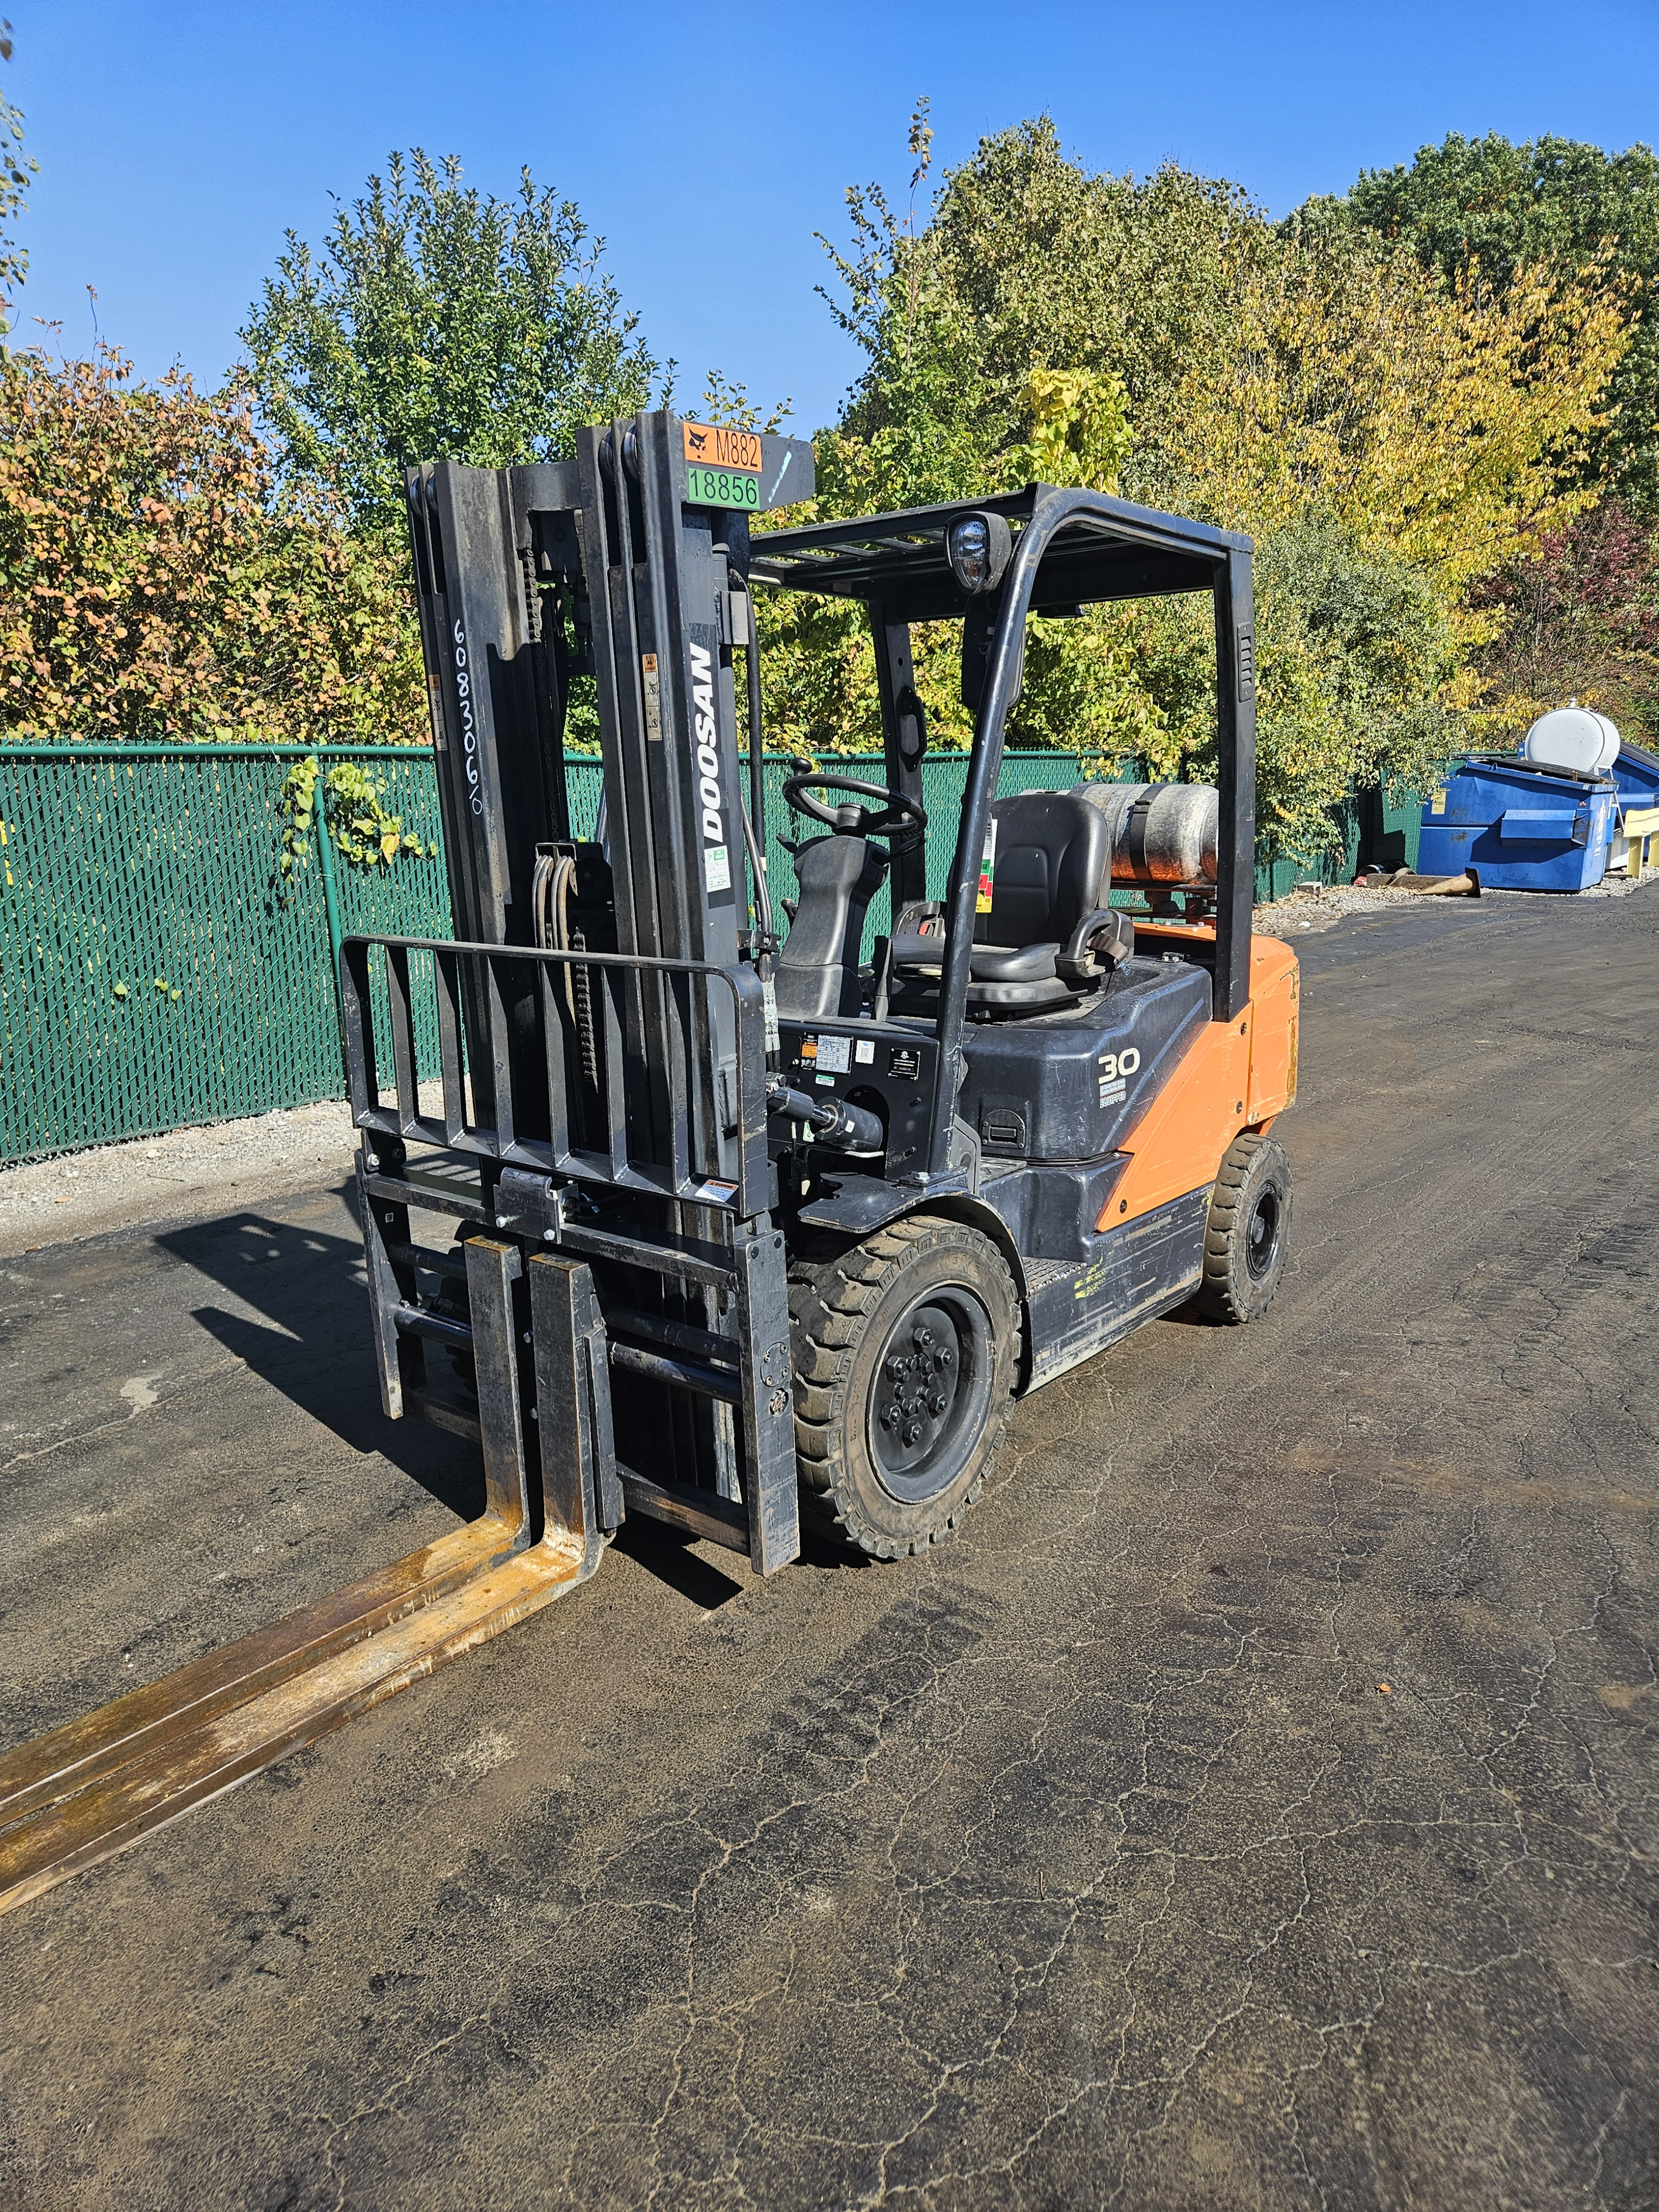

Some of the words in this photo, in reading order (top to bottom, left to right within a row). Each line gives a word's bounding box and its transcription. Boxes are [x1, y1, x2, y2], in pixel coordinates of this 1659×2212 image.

[716, 429, 758, 468] M882
[690, 469, 757, 504] 18856
[689, 642, 723, 843] DOOSAN
[1098, 1047, 1140, 1084] 30
